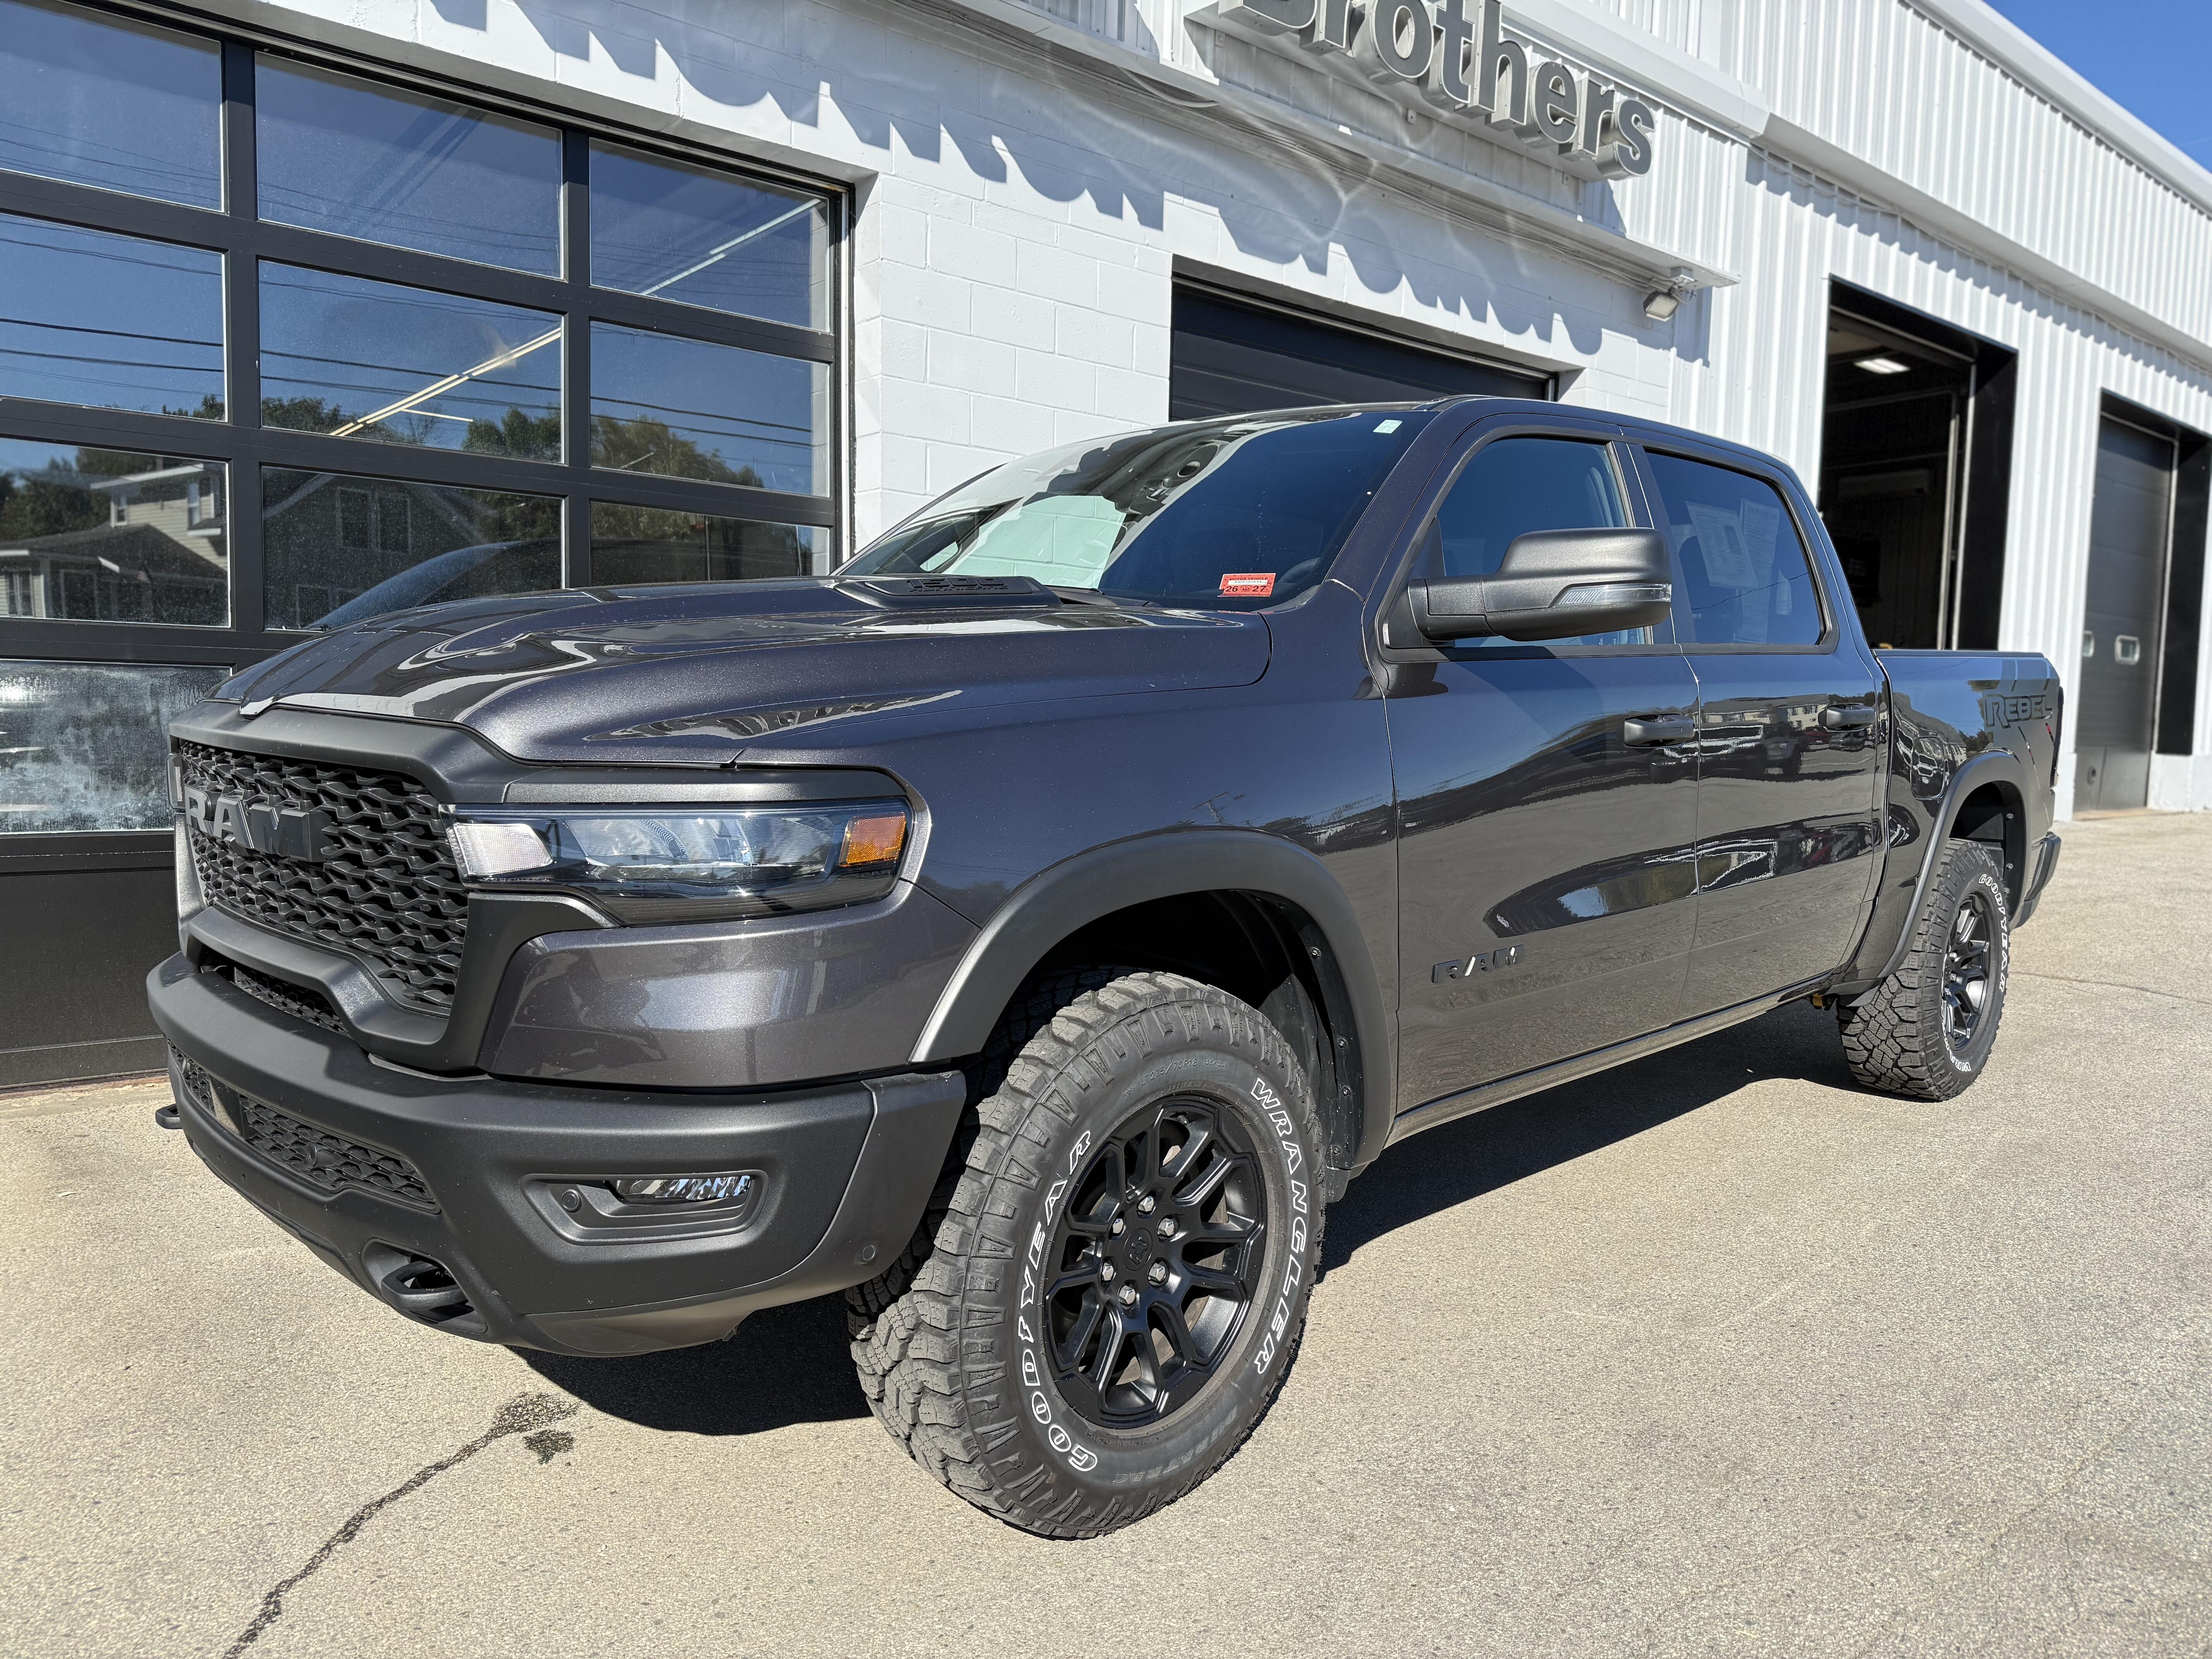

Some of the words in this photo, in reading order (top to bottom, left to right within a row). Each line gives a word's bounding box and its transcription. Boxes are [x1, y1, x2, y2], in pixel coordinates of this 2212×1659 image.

[906, 578, 1004, 588] 1500
[1984, 694, 2052, 729] REBEL
[184, 783, 310, 862] RAM
[1431, 944, 1525, 984] RAM
[1978, 874, 2008, 992] GOODYEAR
[1250, 1078, 1307, 1374] WRANGLER
[1019, 1131, 1097, 1471] GOODYEAR
[1113, 1405, 1238, 1484] DURATRAC
